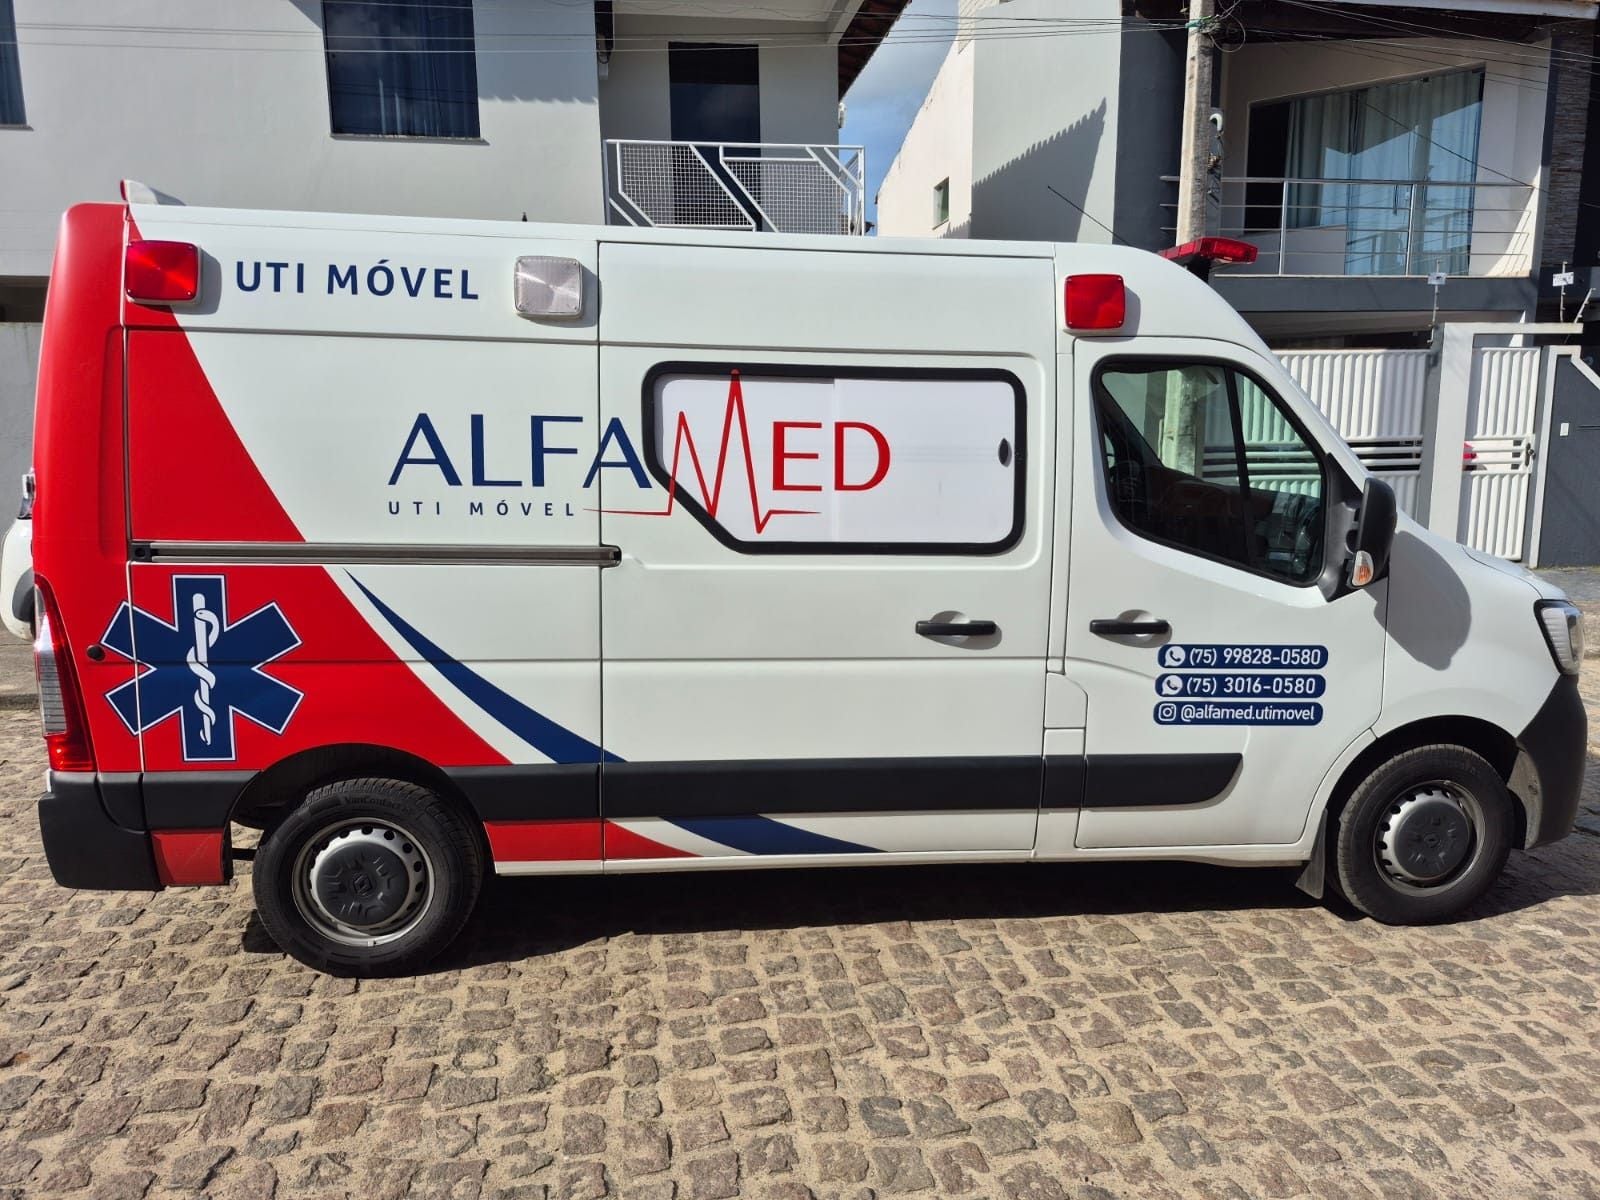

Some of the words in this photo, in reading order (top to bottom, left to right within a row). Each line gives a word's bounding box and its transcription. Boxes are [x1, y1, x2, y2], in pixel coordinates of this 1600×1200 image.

[236, 261, 305, 293] UTI
[327, 259, 479, 300] MÓVEL
[388, 501, 441, 516] UTI
[469, 499, 575, 517] MÓVEL
[1189, 647, 1217, 666] (75)
[1223, 647, 1321, 665] 99828-0580
[1186, 677, 1217, 695] (75)
[1223, 677, 1316, 694] 3016-0580
[1181, 704, 1315, 722] @alfamed.utimovel
